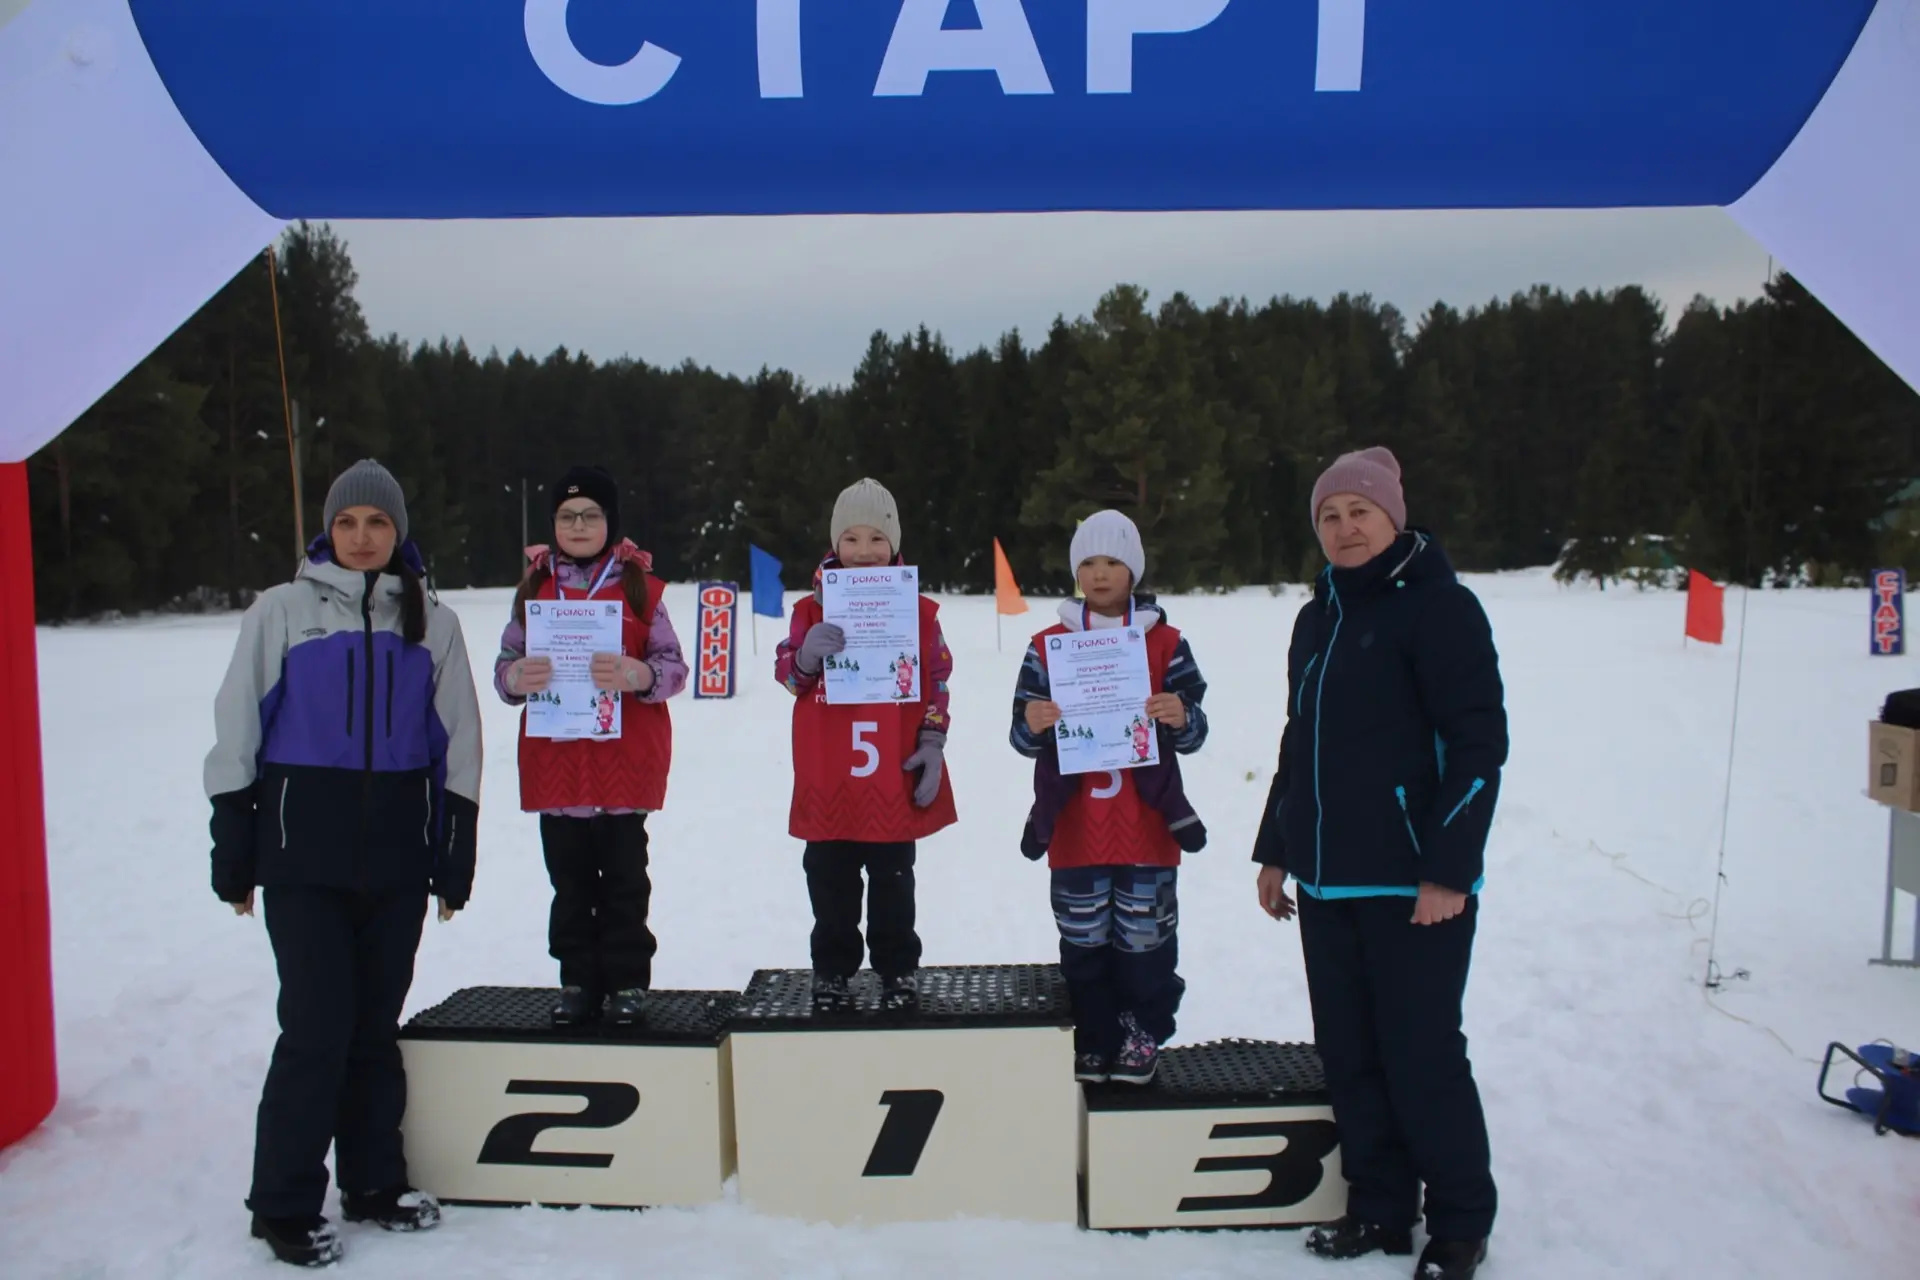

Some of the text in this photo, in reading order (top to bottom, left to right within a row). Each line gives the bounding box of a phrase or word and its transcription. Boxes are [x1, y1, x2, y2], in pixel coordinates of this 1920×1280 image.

[550, 606, 596, 618] Грамота
[846, 574, 892, 585] Грамота
[1875, 571, 1899, 653] СТАРТ
[700, 586, 735, 695] ФИНИШ
[1071, 637, 1118, 650] Грамота
[850, 721, 880, 778] 5
[477, 1079, 640, 1168] 2
[861, 1089, 945, 1177] 1
[1176, 1119, 1340, 1213] 3
